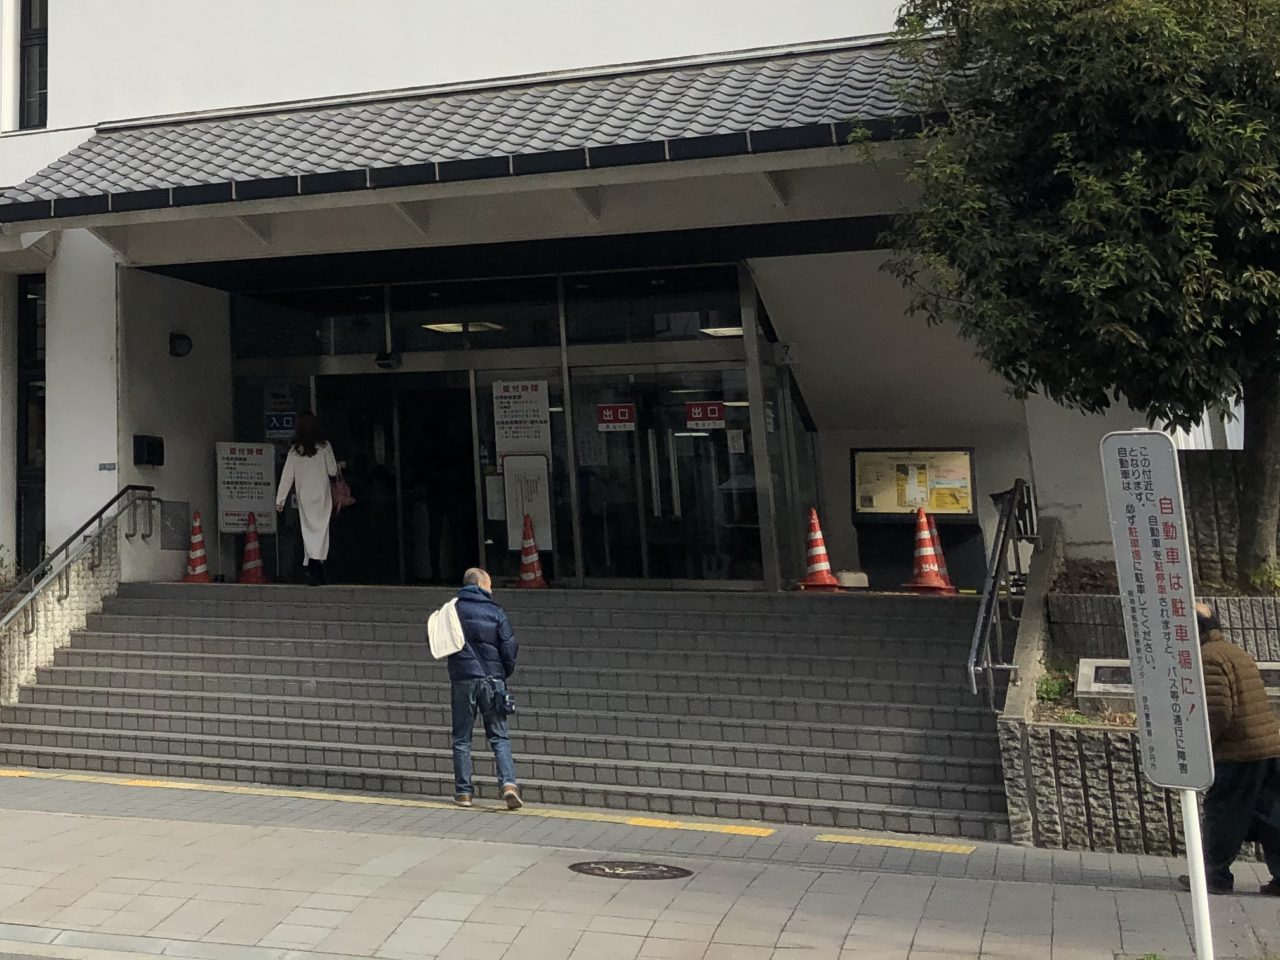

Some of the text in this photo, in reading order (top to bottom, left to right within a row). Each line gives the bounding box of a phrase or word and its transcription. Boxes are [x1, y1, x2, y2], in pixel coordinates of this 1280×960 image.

[602, 408, 629, 421] 出口
[691, 406, 718, 418] 出口
[270, 416, 293, 428] 入口
